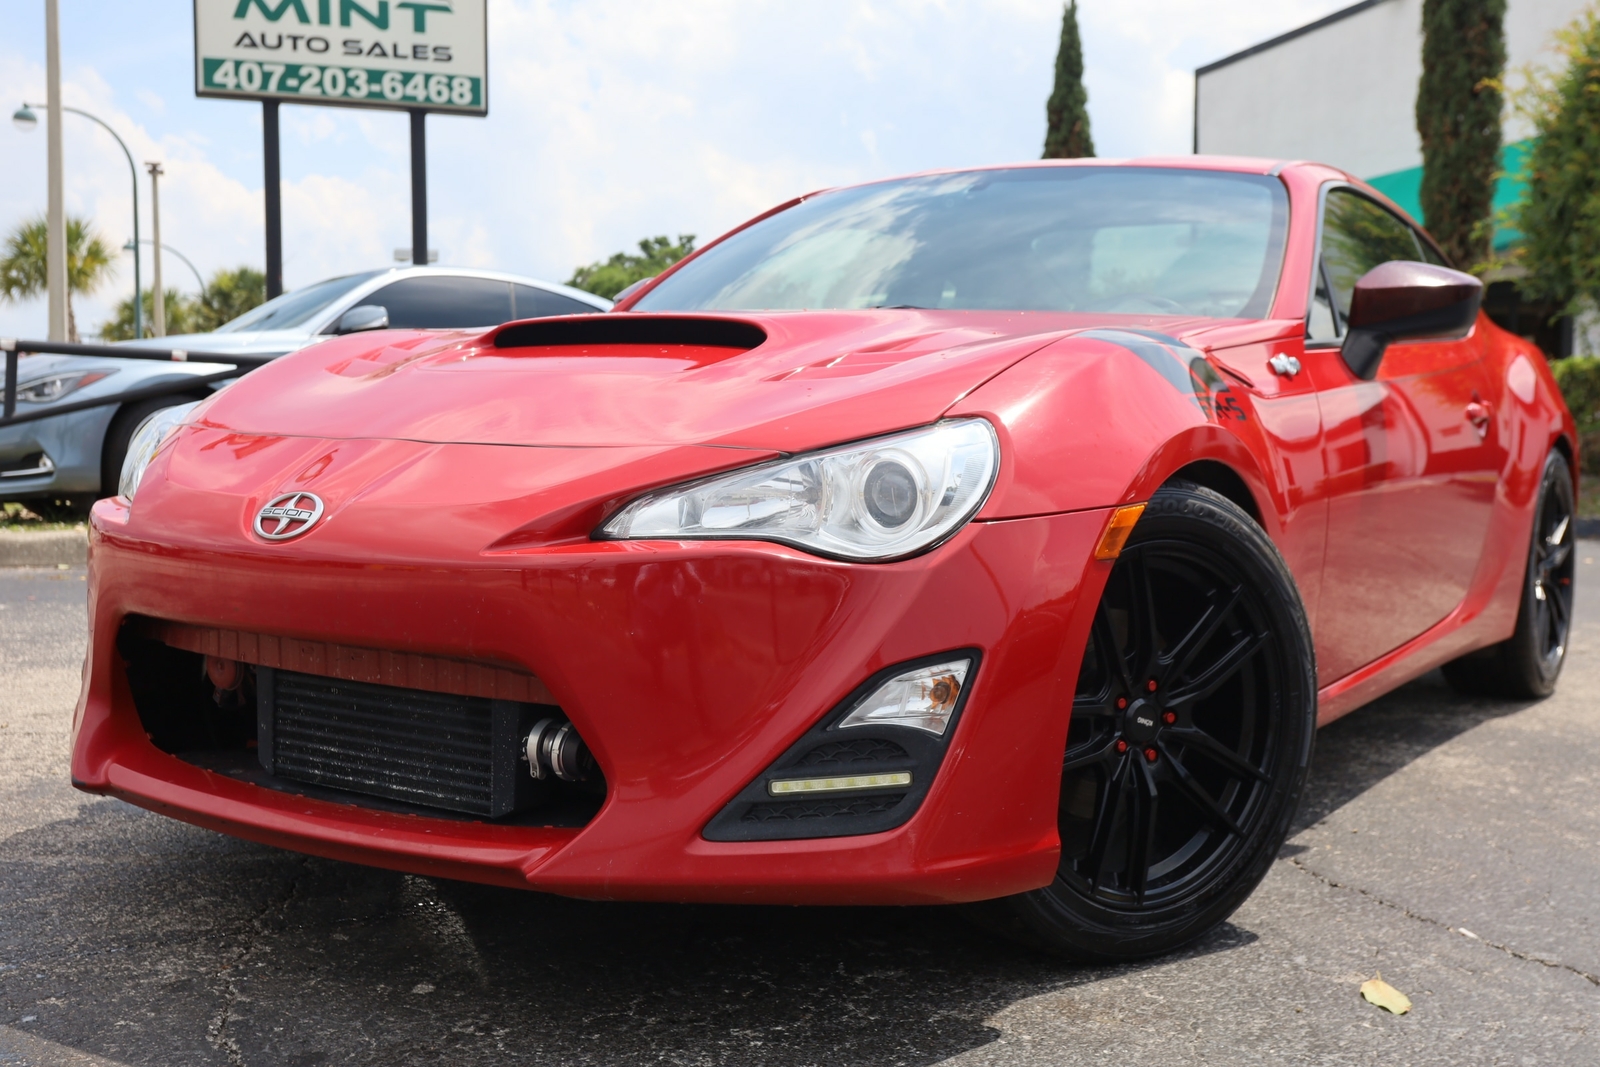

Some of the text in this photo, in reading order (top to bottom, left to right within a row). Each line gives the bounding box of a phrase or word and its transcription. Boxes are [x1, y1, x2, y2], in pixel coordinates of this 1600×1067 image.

[233, 0, 453, 33] MINT
[234, 31, 453, 63] AUTO SALES
[211, 59, 474, 106] 407-203-6468
[261, 508, 313, 518] SCION
